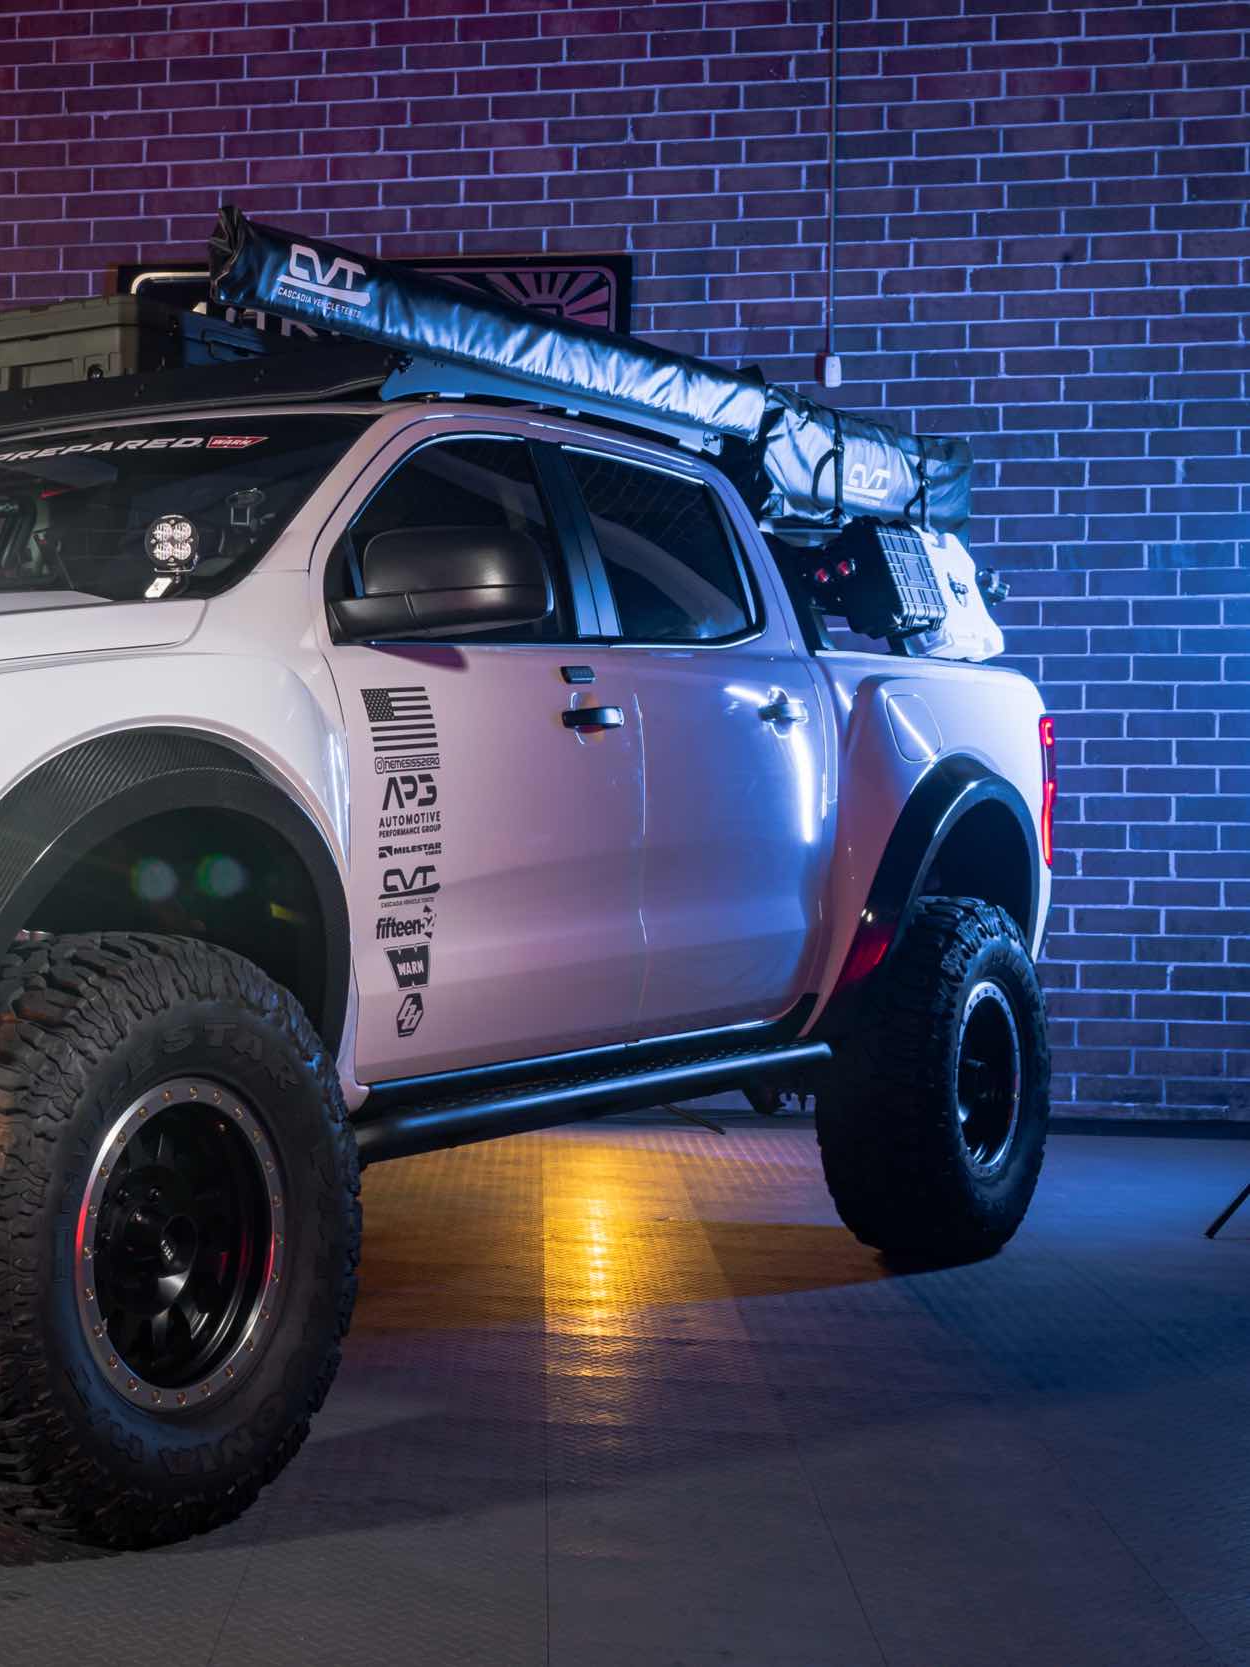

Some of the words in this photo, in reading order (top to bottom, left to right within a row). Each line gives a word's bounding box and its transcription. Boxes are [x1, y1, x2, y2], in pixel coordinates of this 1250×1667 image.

[289, 243, 366, 290] CVT
[278, 287, 311, 304] CASCADIA
[848, 463, 891, 489] CVT
[379, 810, 441, 829] AUTOMOTIVE
[379, 827, 420, 838] PERFORMANCE
[421, 823, 442, 834] GROUP
[393, 842, 442, 855] MILESTAR
[383, 864, 436, 893] CVT
[396, 960, 425, 976] WARN
